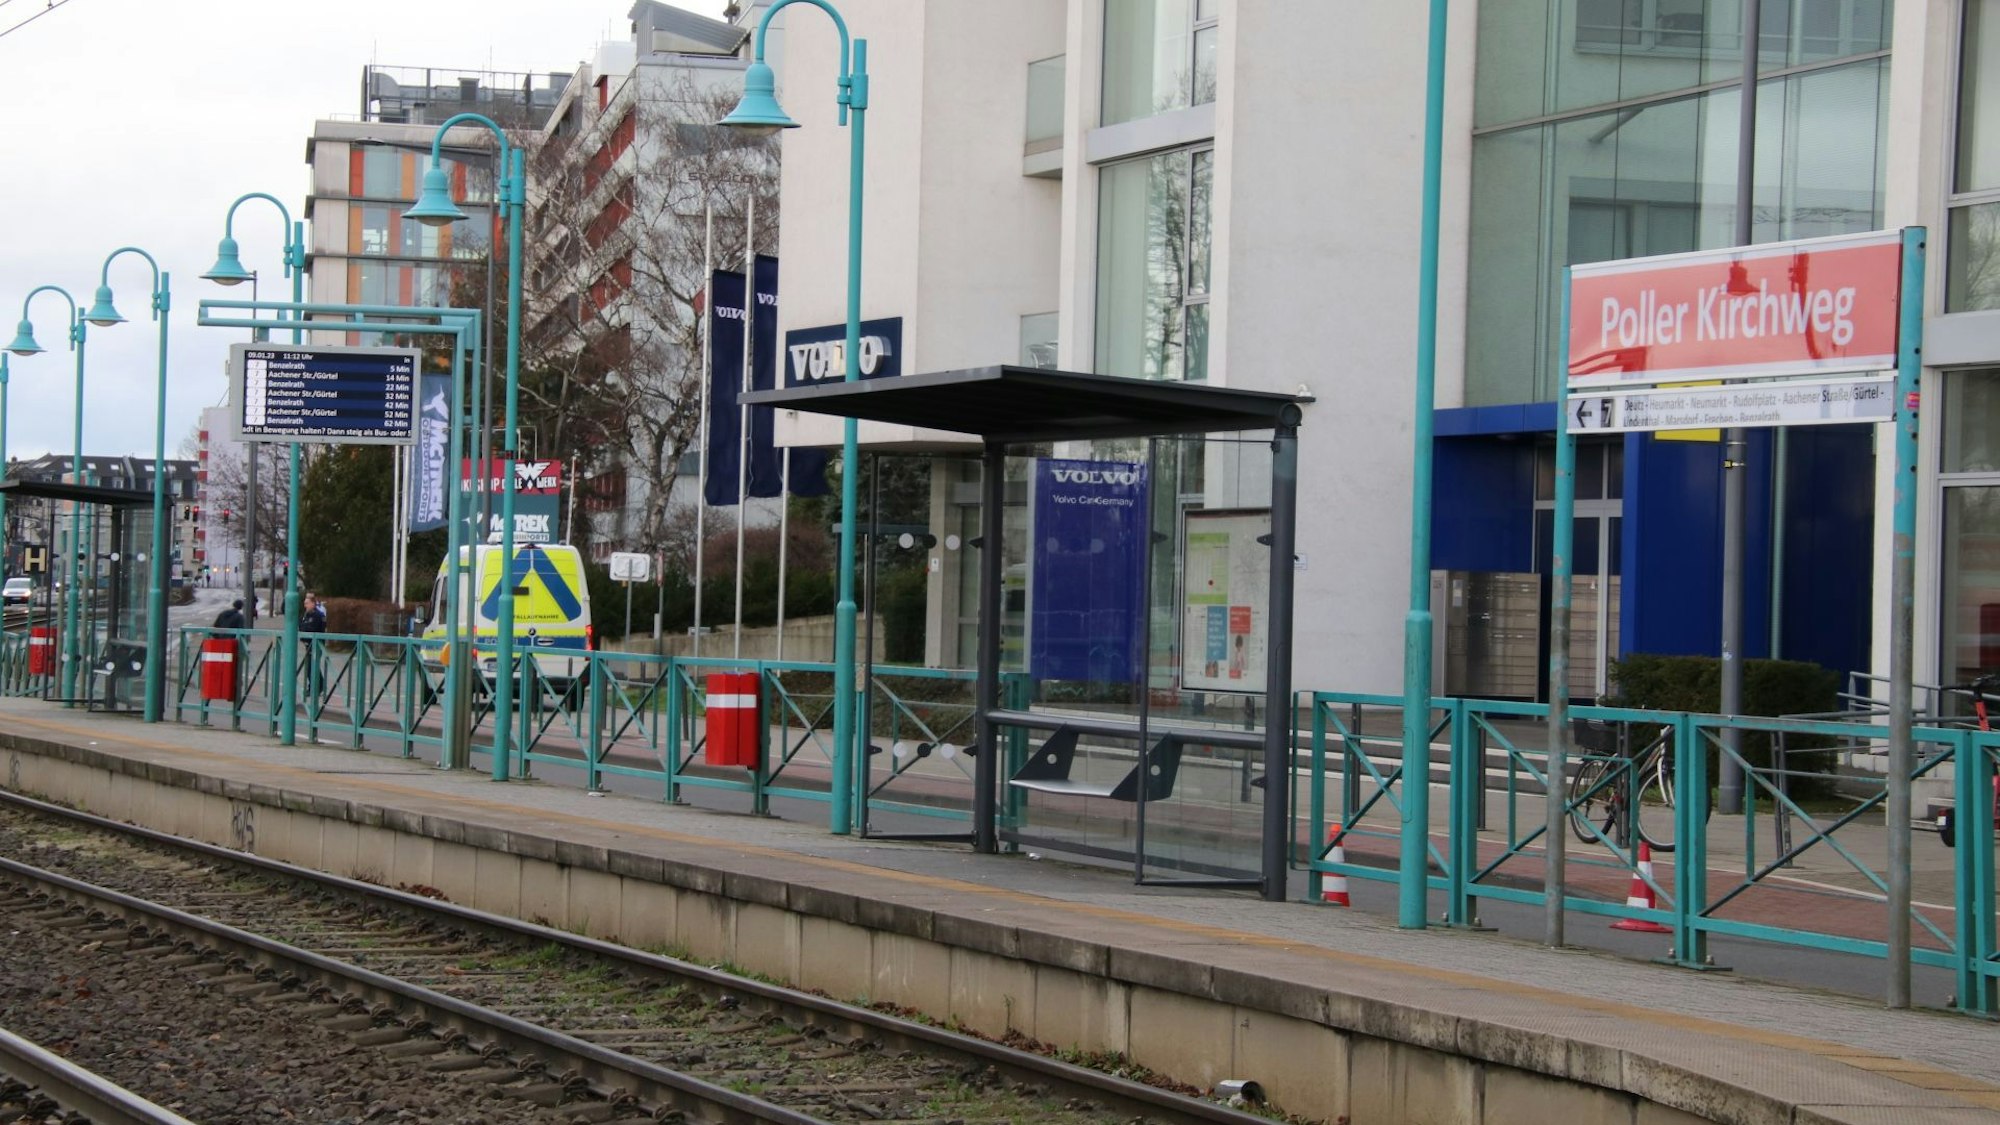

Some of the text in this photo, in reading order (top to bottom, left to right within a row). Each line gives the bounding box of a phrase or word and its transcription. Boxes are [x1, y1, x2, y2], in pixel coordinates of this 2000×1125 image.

[1601, 278, 1856, 349] Poller Kirchweg
[268, 362, 306, 370] Benzelrath
[268, 398, 304, 406] Benzelrath
[1624, 399, 1644, 412] Deutz
[1650, 397, 1684, 410] Heumarkt
[1691, 396, 1727, 408] Neumarkt
[1734, 392, 1776, 408] Rudolfplatz
[1782, 390, 1820, 404] Aachener
[1624, 411, 1780, 427] Lindenthal Marsdorf Frechen Benzelrath
[263, 426, 298, 435] Bewegung
[346, 428, 362, 436] steig
[1052, 470, 1136, 486] VOLVO
[1052, 494, 1076, 504] Volvo
[1094, 496, 1134, 508] Germany
[24, 547, 46, 572] H
